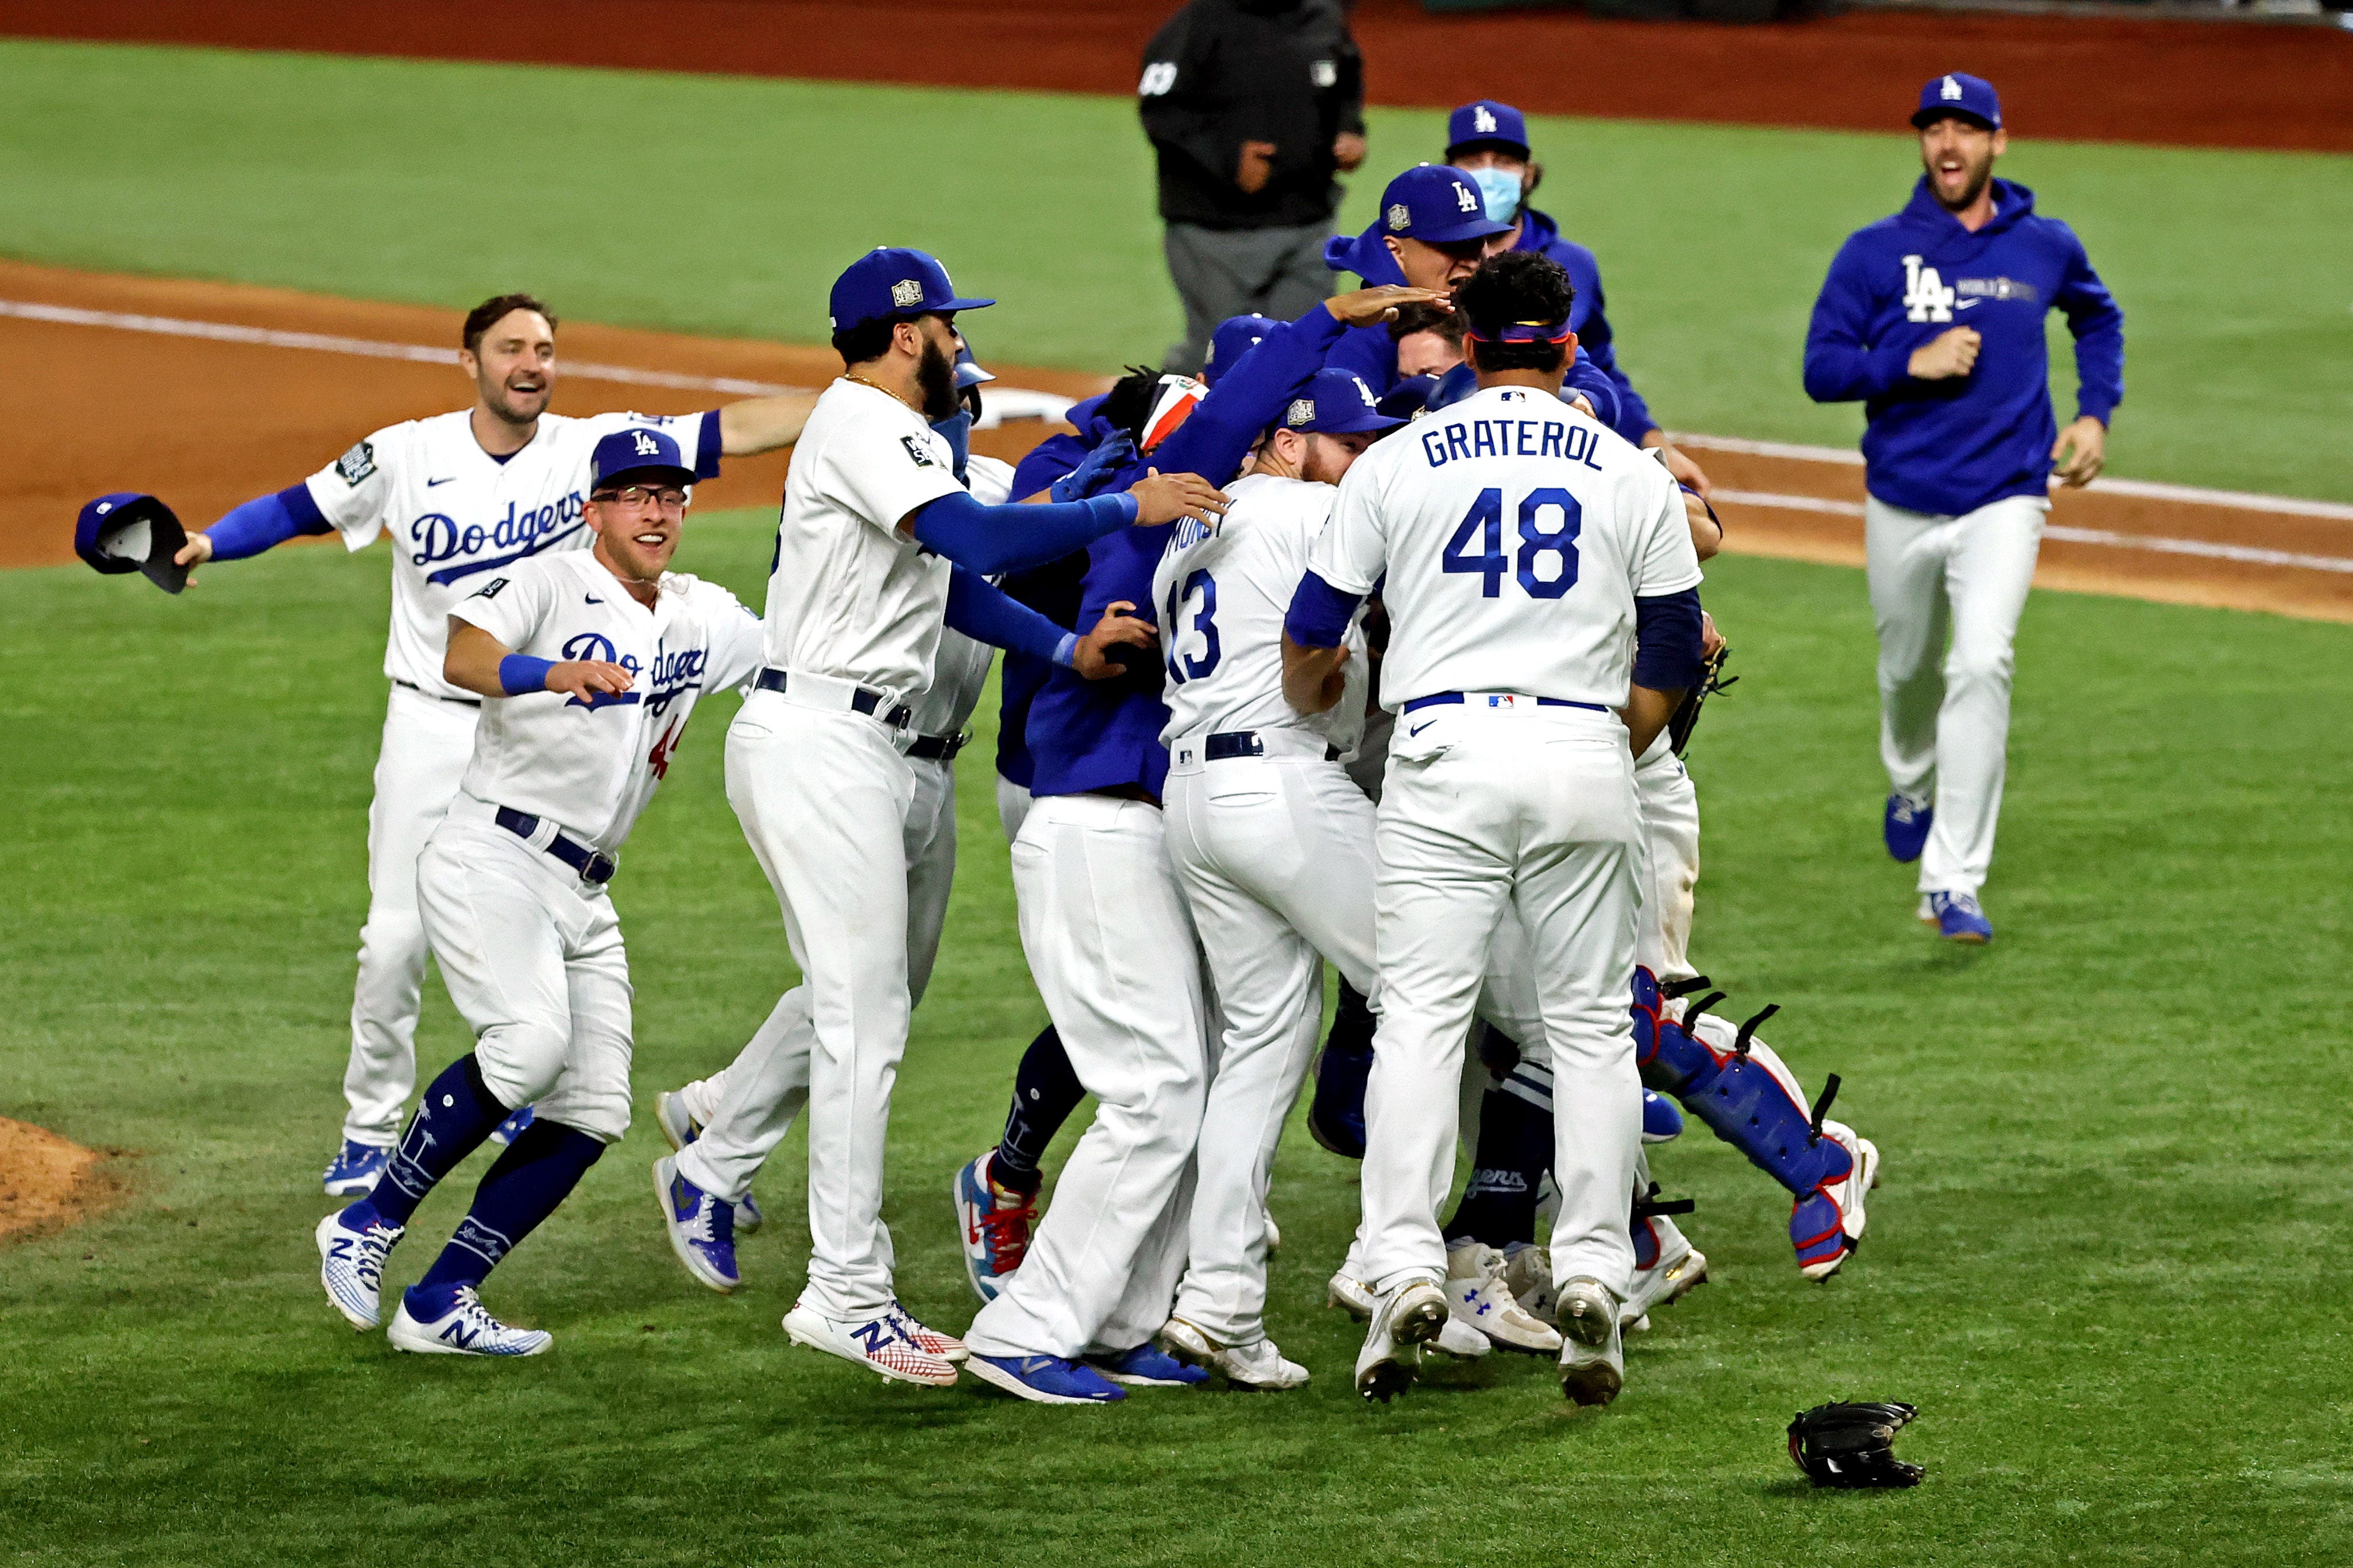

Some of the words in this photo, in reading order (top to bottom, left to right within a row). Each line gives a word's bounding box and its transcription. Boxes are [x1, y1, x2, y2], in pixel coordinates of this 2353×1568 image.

[1941, 75, 1962, 100] LA
[1474, 106, 1497, 133] LA
[1452, 181, 1478, 212] LA
[1902, 254, 1955, 323] LA
[631, 431, 660, 456] LA
[1421, 420, 1602, 471] GRATEROL
[411, 491, 584, 565] Dodgers
[1442, 487, 1582, 599] 48
[1166, 568, 1221, 685] 13
